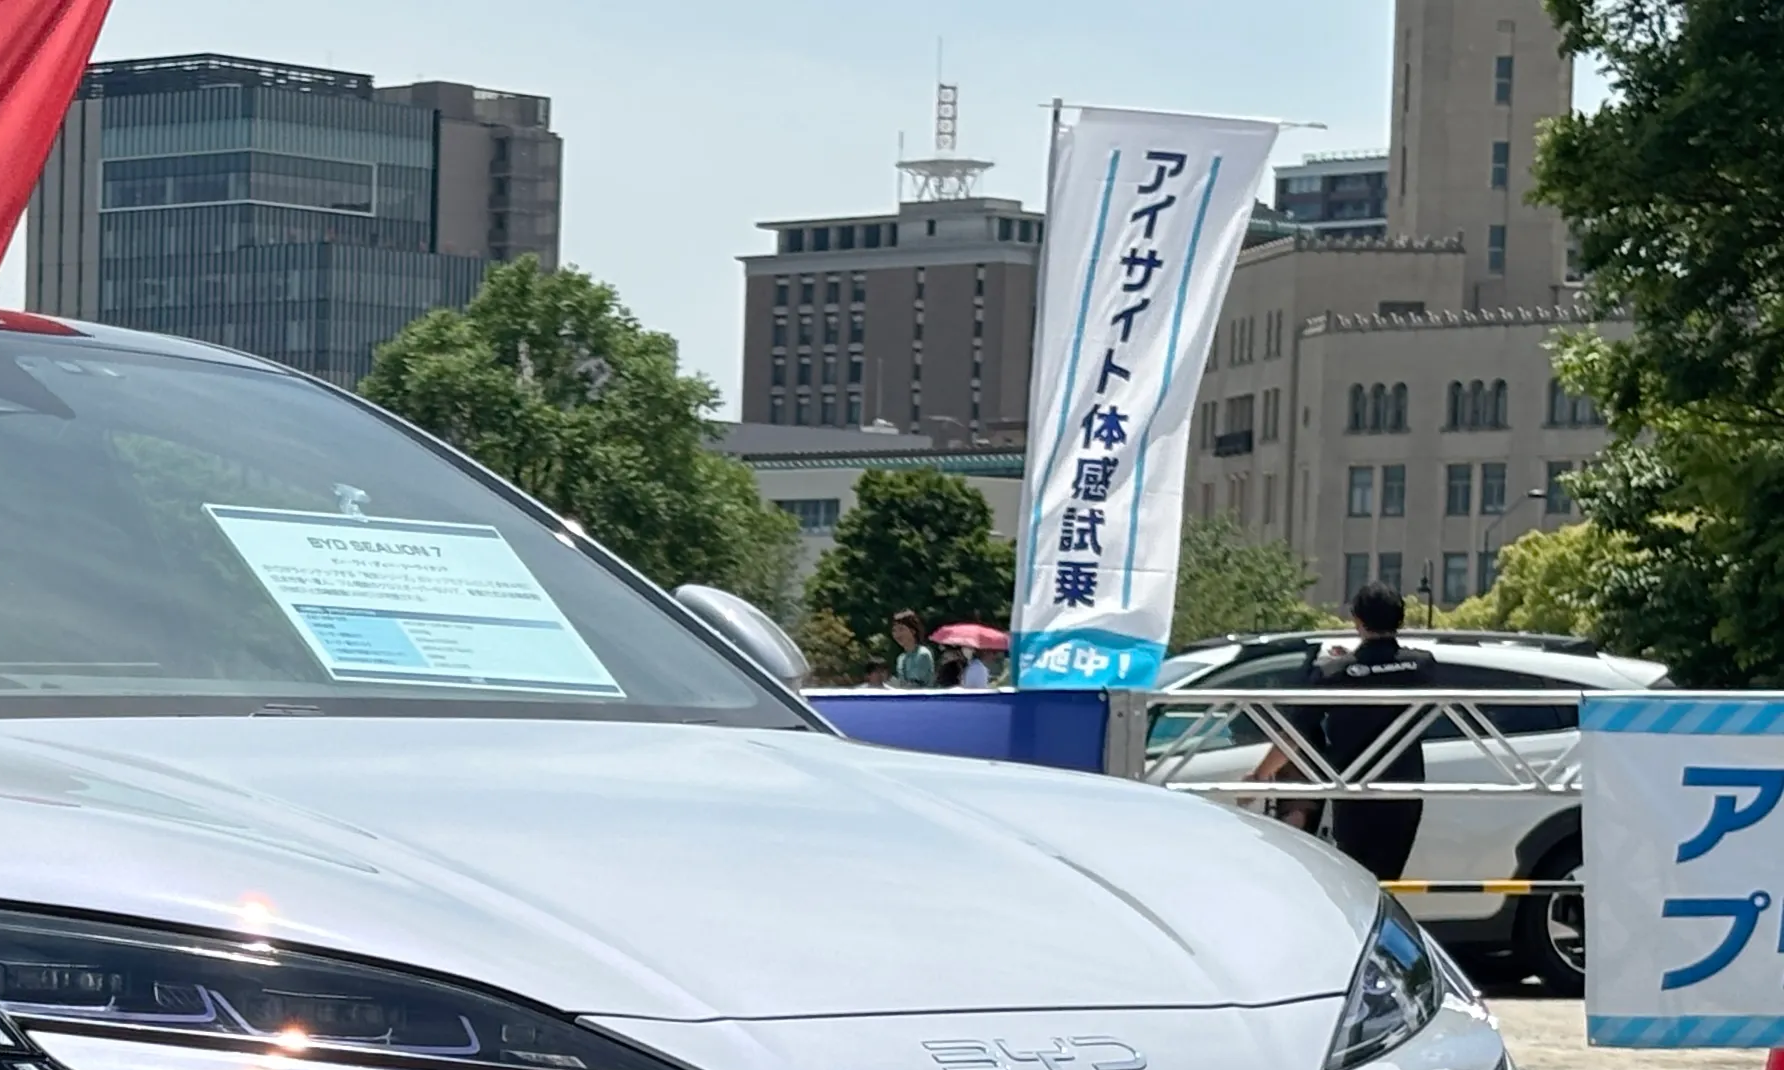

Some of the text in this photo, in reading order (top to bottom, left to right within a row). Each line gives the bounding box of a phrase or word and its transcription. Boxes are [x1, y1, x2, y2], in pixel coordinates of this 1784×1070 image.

[1053, 150, 1188, 609] アイサイト体感試乗
[306, 536, 442, 558] BYD SEALION 7
[1661, 890, 1784, 992] プ
